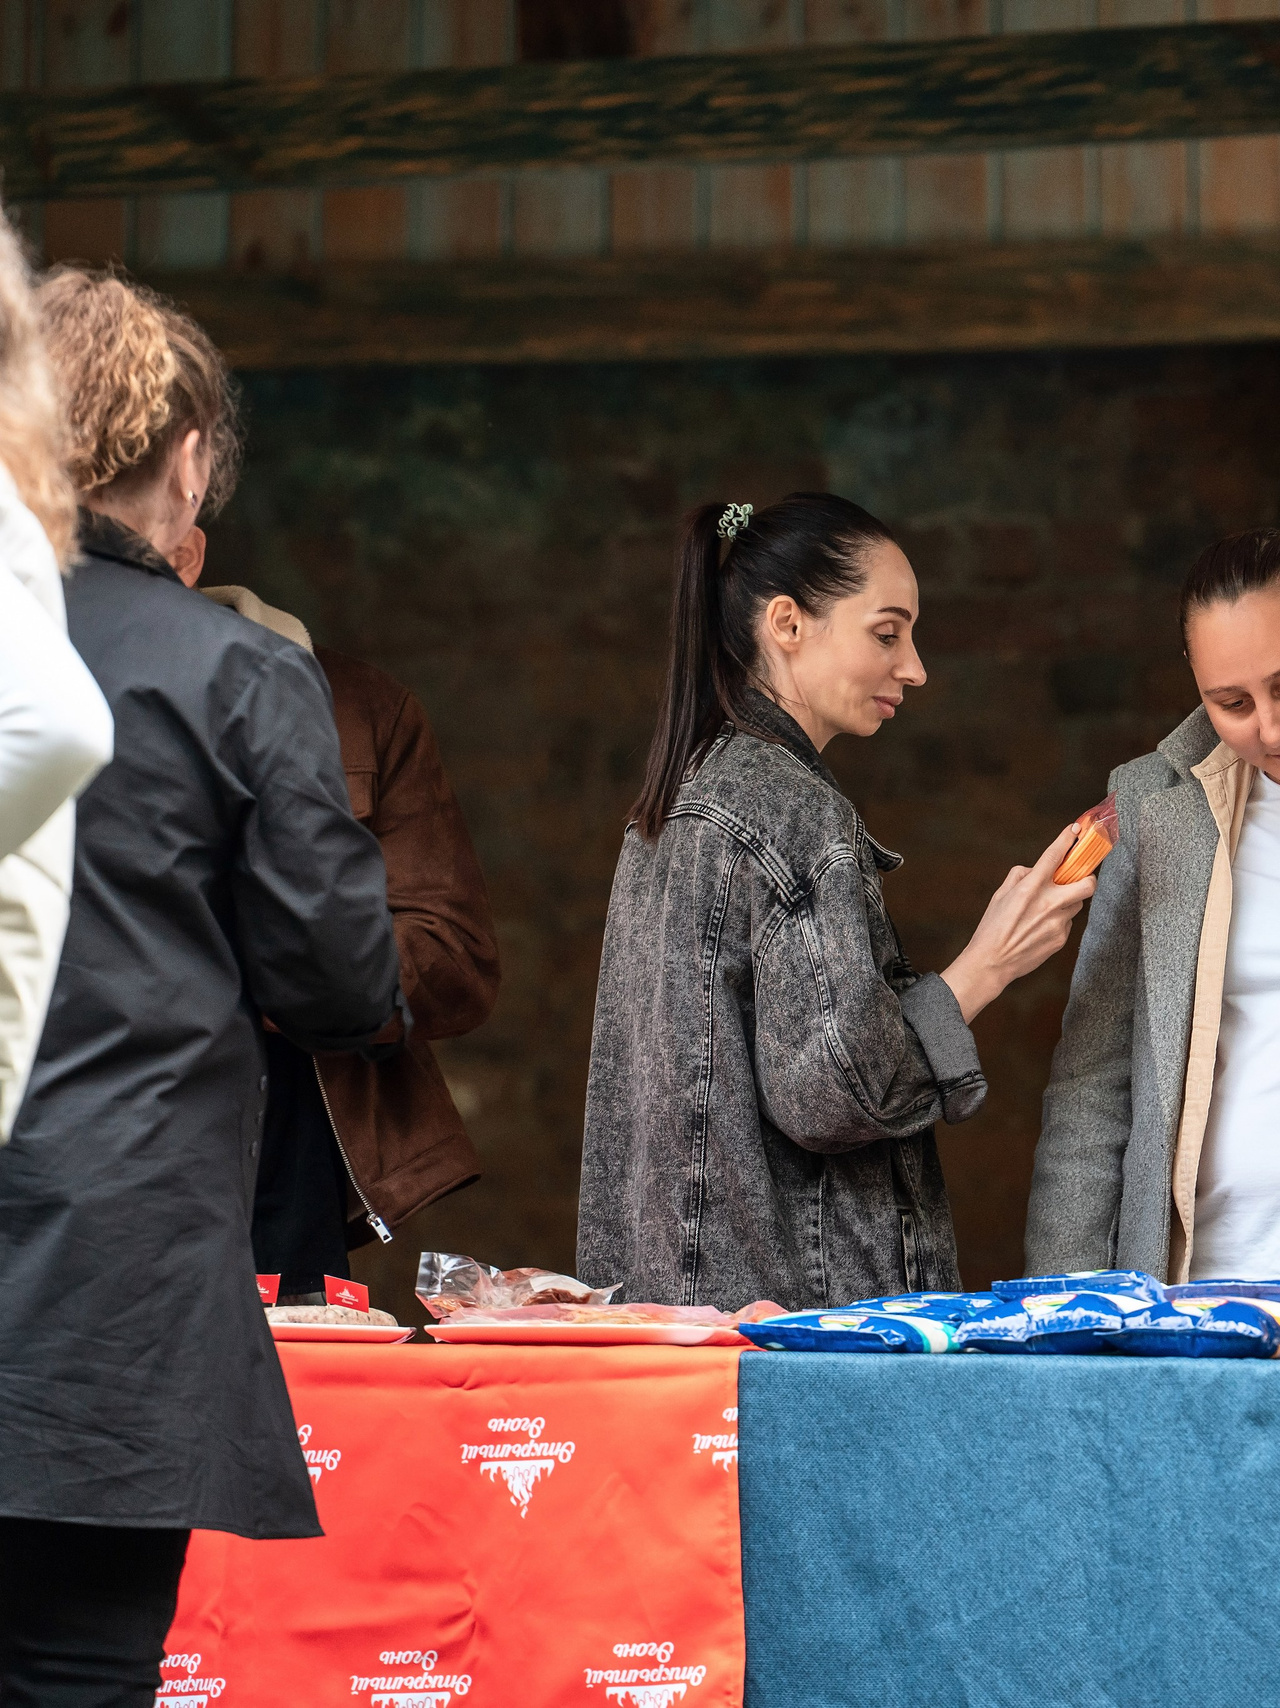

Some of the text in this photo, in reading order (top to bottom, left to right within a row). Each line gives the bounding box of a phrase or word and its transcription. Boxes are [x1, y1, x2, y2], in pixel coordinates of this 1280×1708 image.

[487, 1416, 546, 1439] Огонь
[460, 1438, 576, 1464] Открытый
[379, 1648, 439, 1671] Огонь
[612, 1640, 675, 1663] Огонь
[159, 1653, 202, 1675] Огон
[583, 1663, 707, 1688] Открытый
[349, 1672, 473, 1696] Открытый
